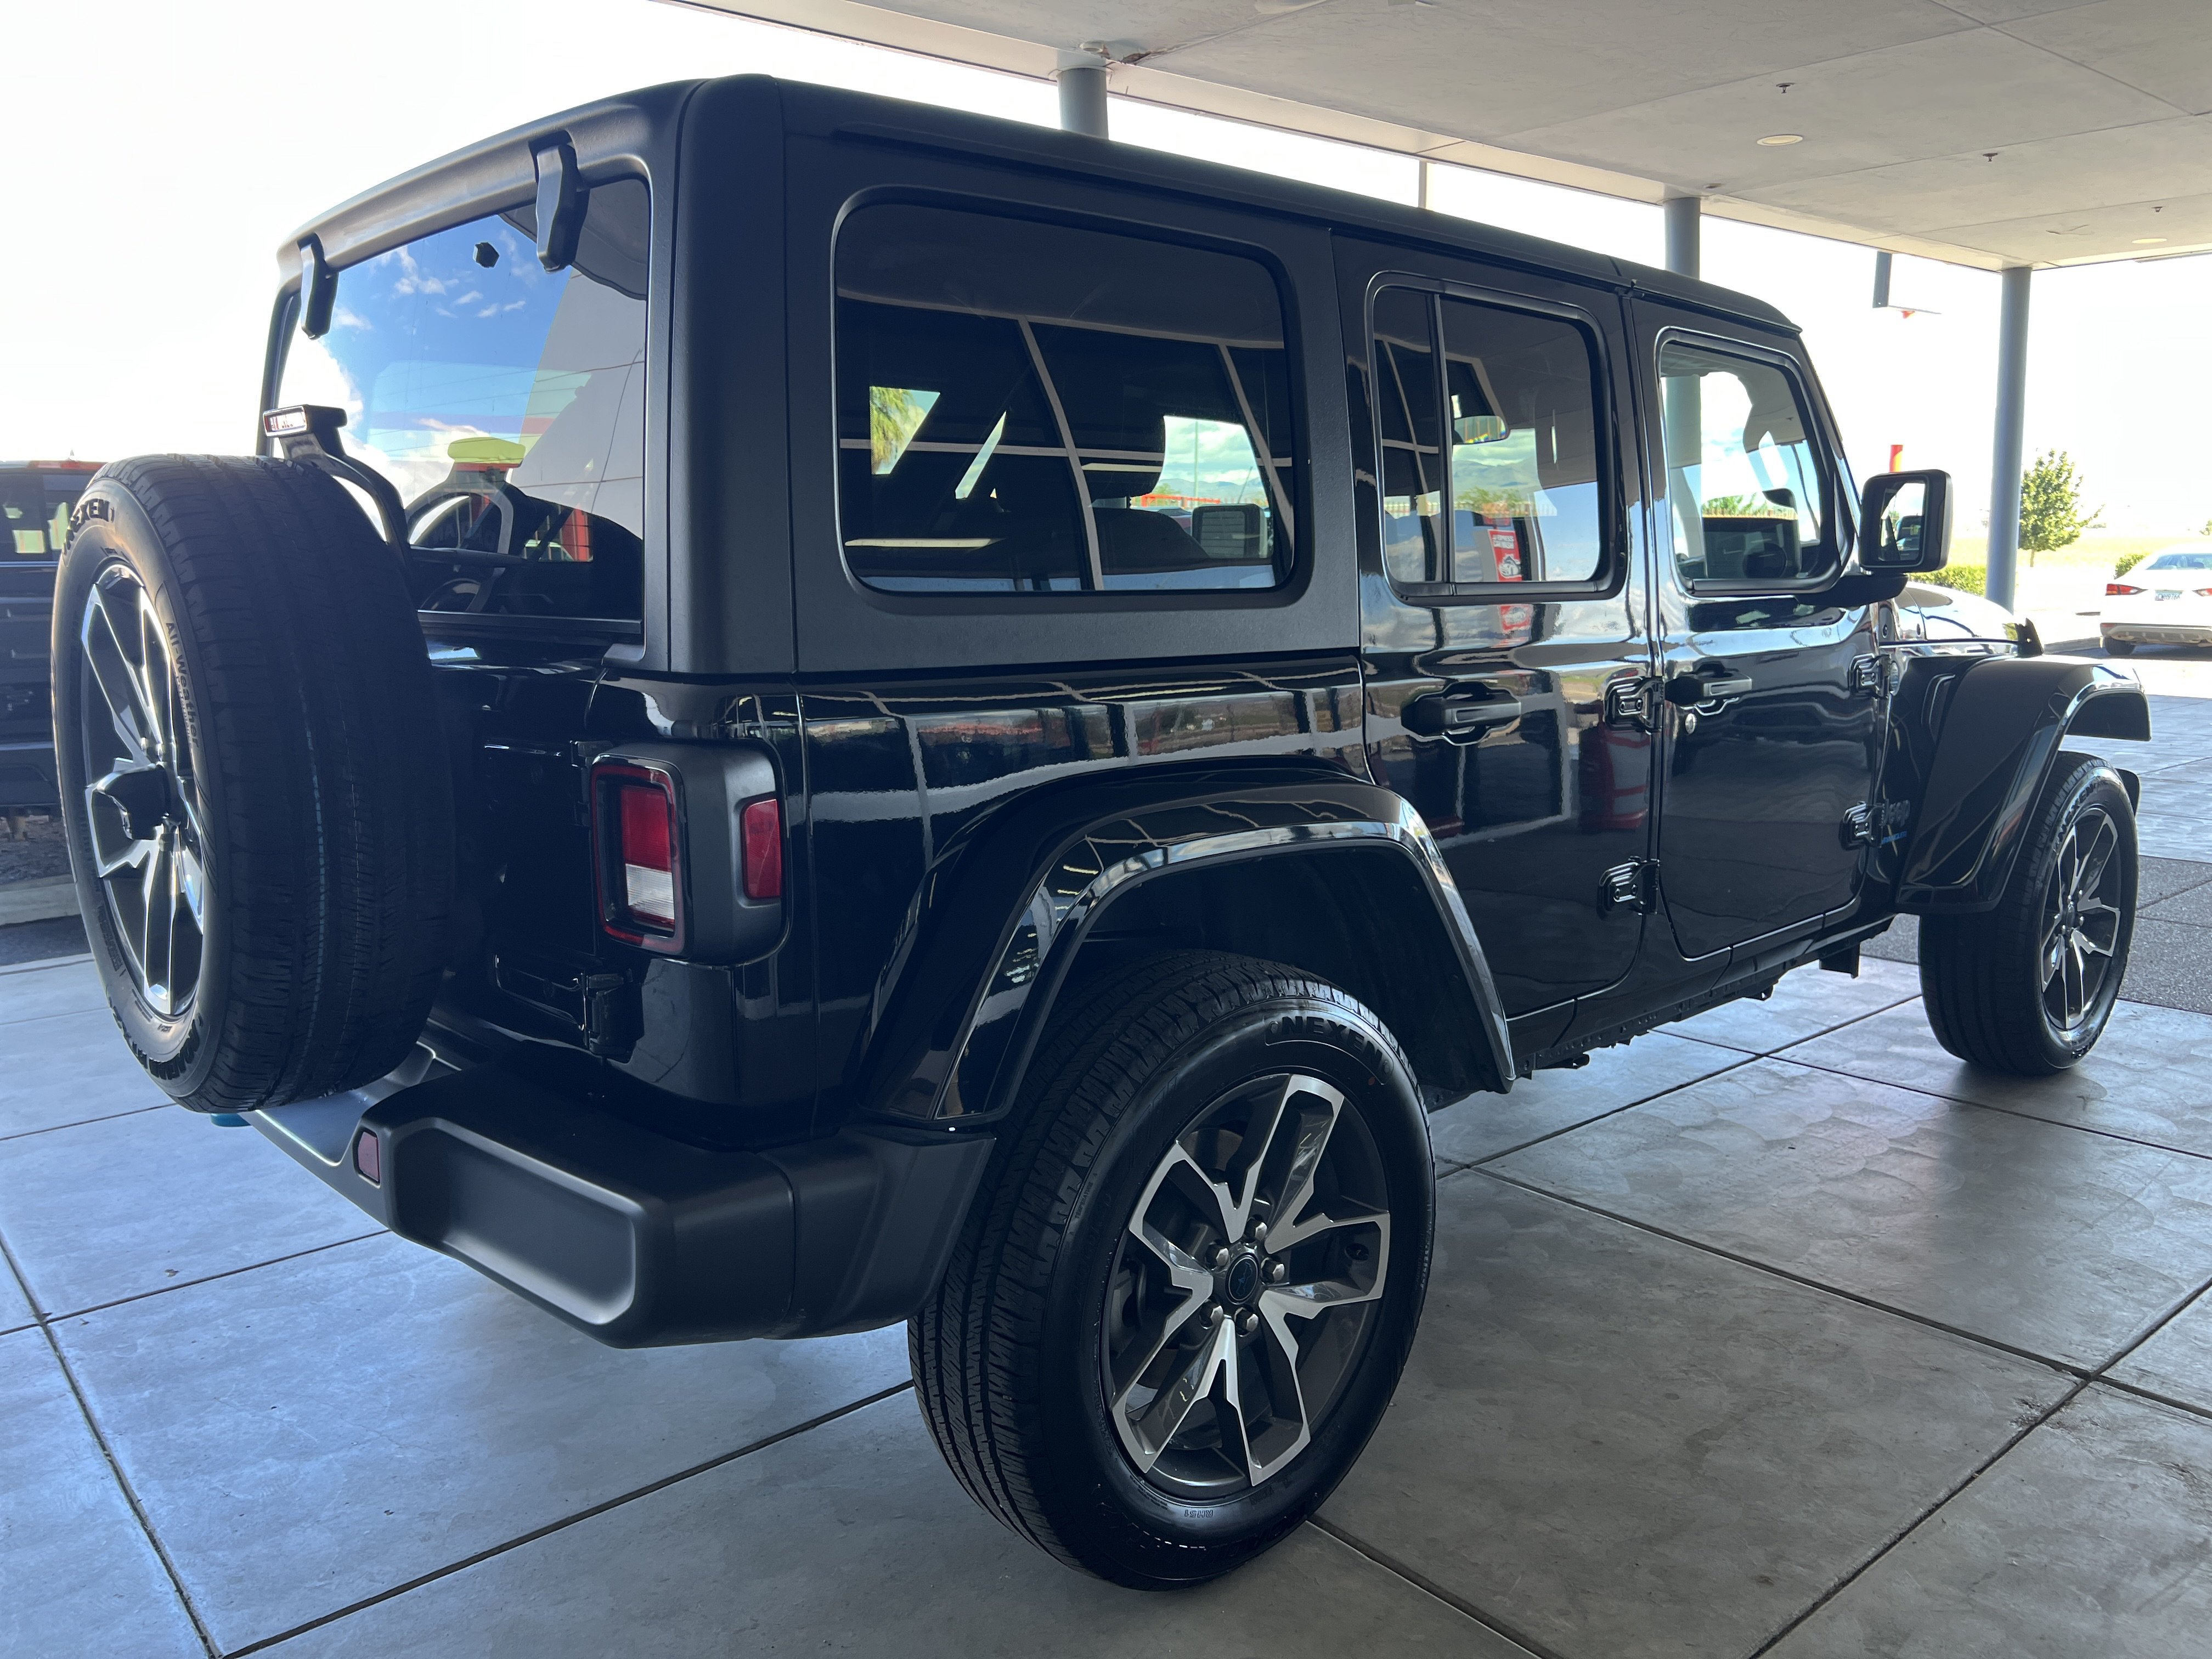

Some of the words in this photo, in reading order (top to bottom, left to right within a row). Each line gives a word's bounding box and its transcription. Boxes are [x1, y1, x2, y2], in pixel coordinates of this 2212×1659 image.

[166, 622, 200, 749] All-Weather
[1880, 798, 1911, 827] Jeep
[1282, 1016, 1383, 1069] NEXEN
[1184, 1509, 1214, 1518] RH51
